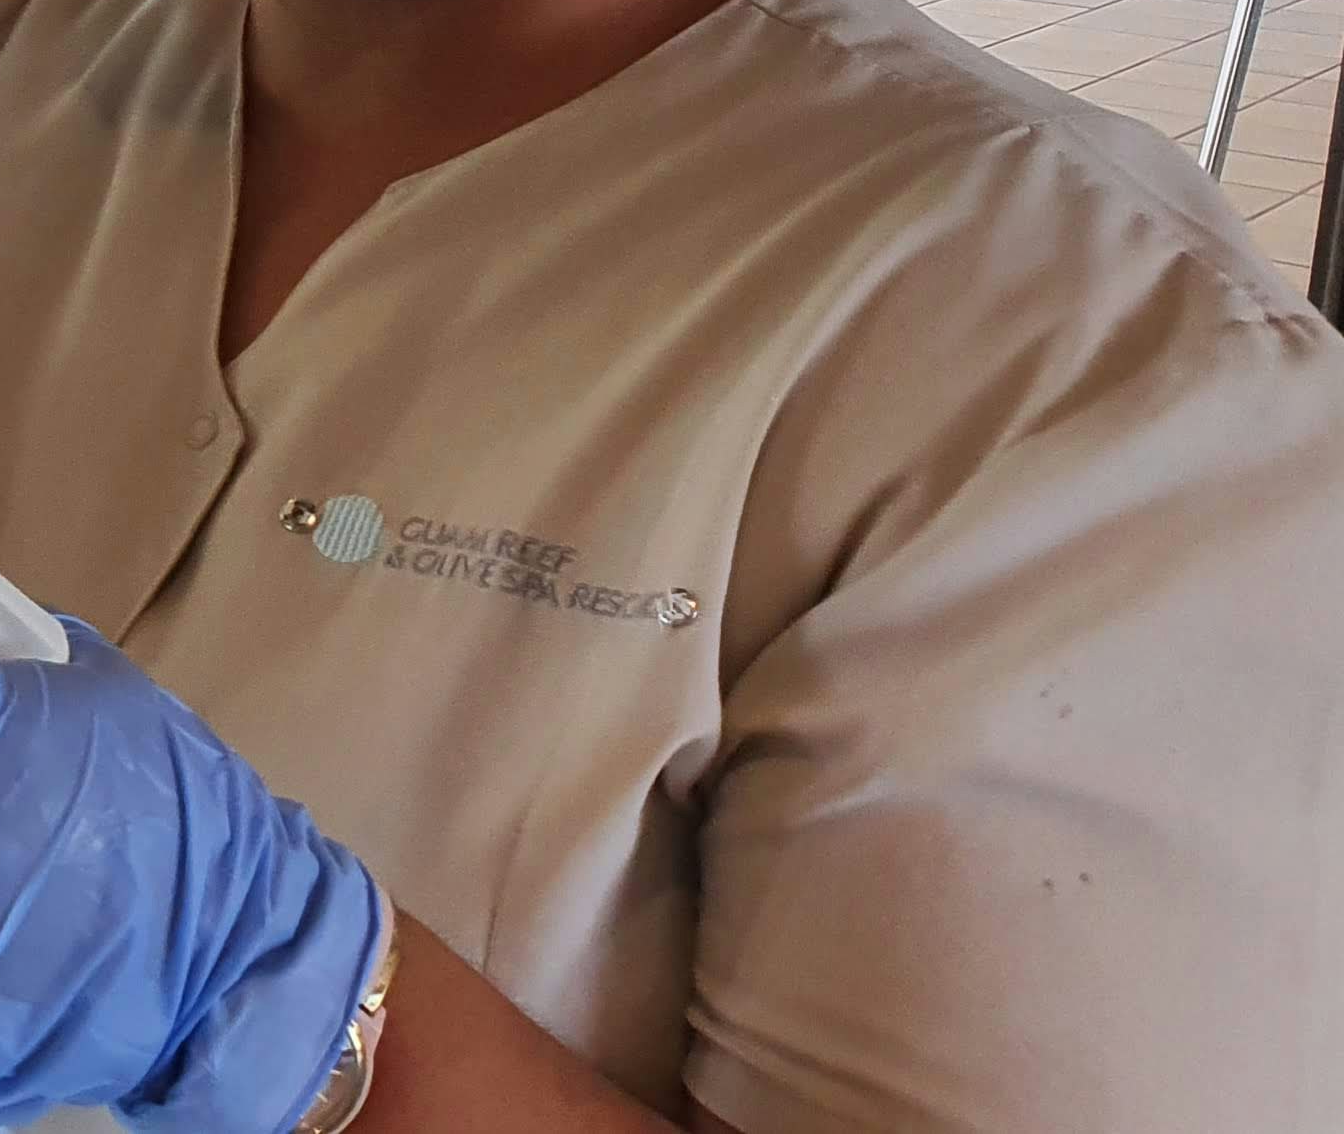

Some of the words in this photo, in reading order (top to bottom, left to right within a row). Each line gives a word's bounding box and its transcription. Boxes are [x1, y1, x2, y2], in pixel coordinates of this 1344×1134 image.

[383, 546, 406, 569] &
[498, 564, 559, 608] SPA
[495, 529, 578, 573] REEF
